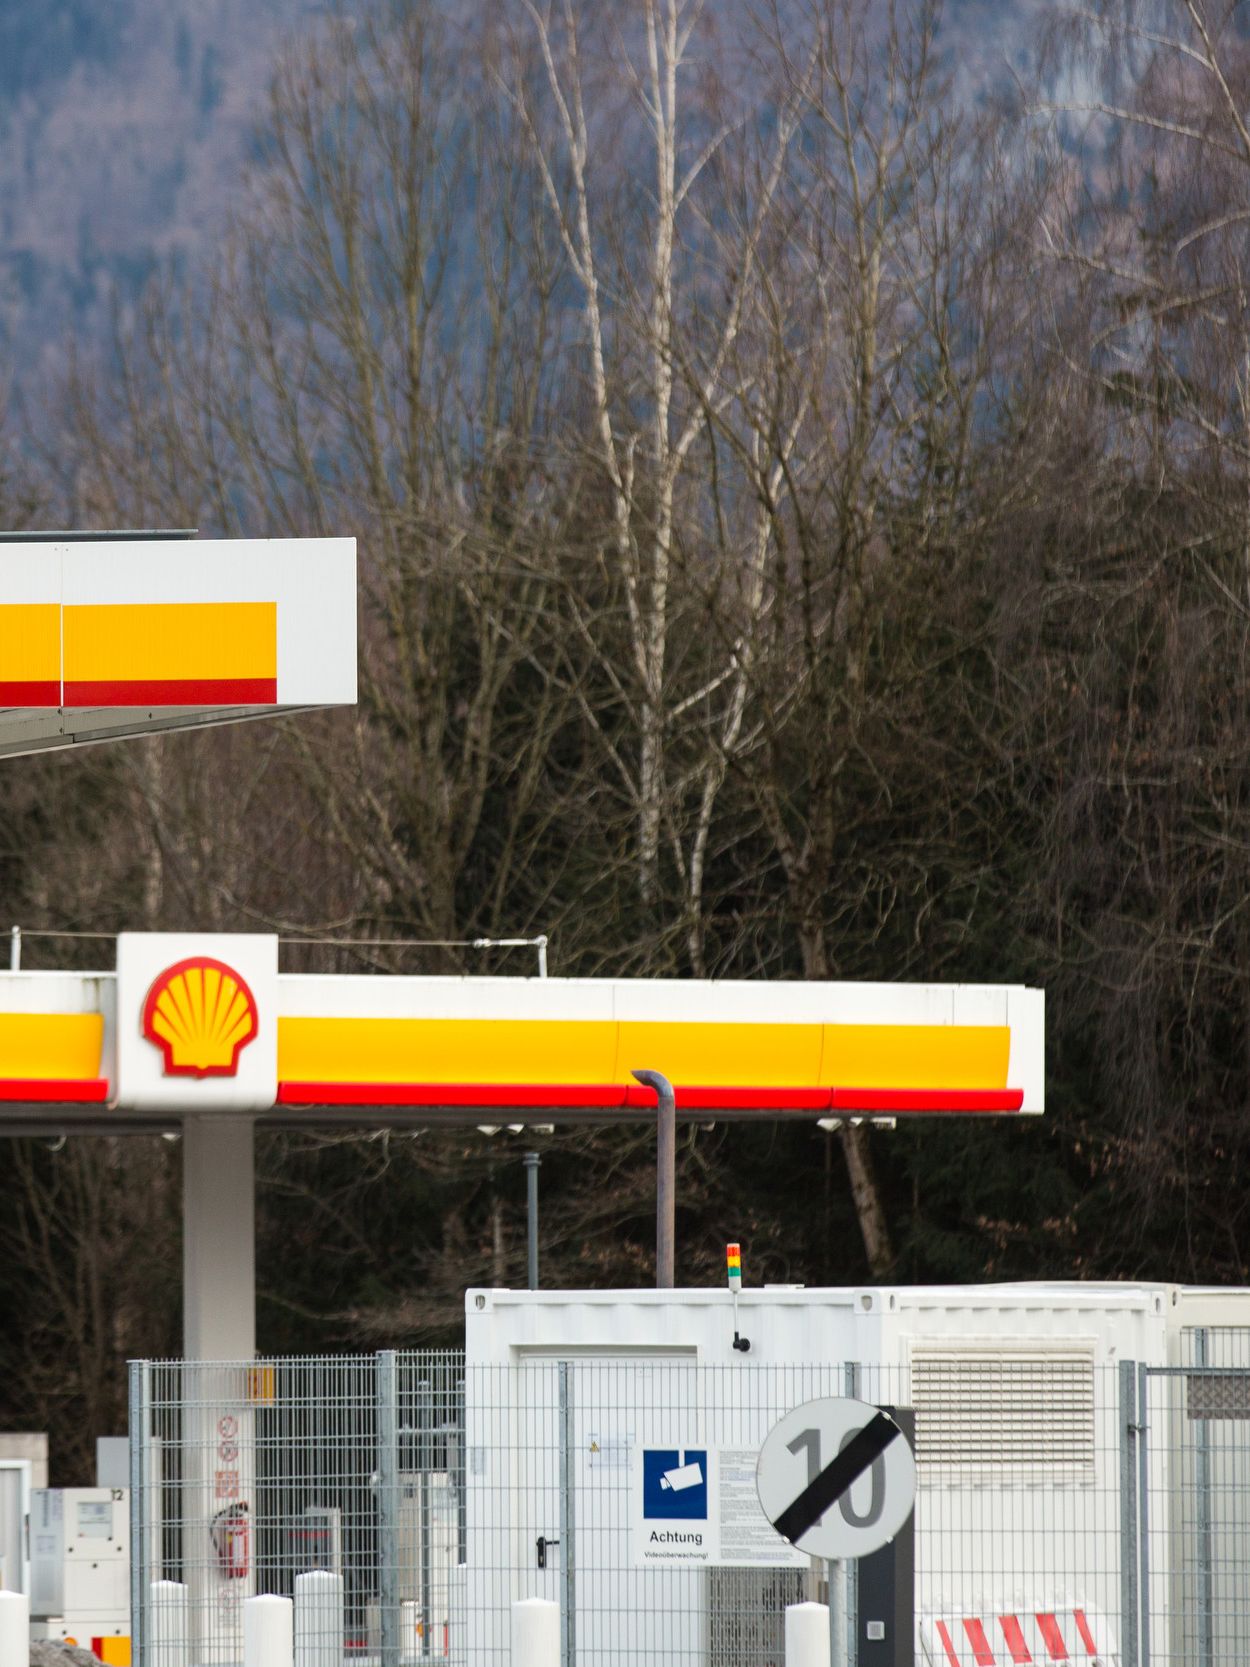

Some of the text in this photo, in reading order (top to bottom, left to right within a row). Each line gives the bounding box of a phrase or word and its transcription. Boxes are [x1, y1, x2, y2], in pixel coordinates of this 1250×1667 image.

[786, 1427, 886, 1528] 10
[110, 1489, 124, 1500] 12
[649, 1531, 703, 1546] Achtung
[644, 1551, 708, 1560] Videoüberwachung!
